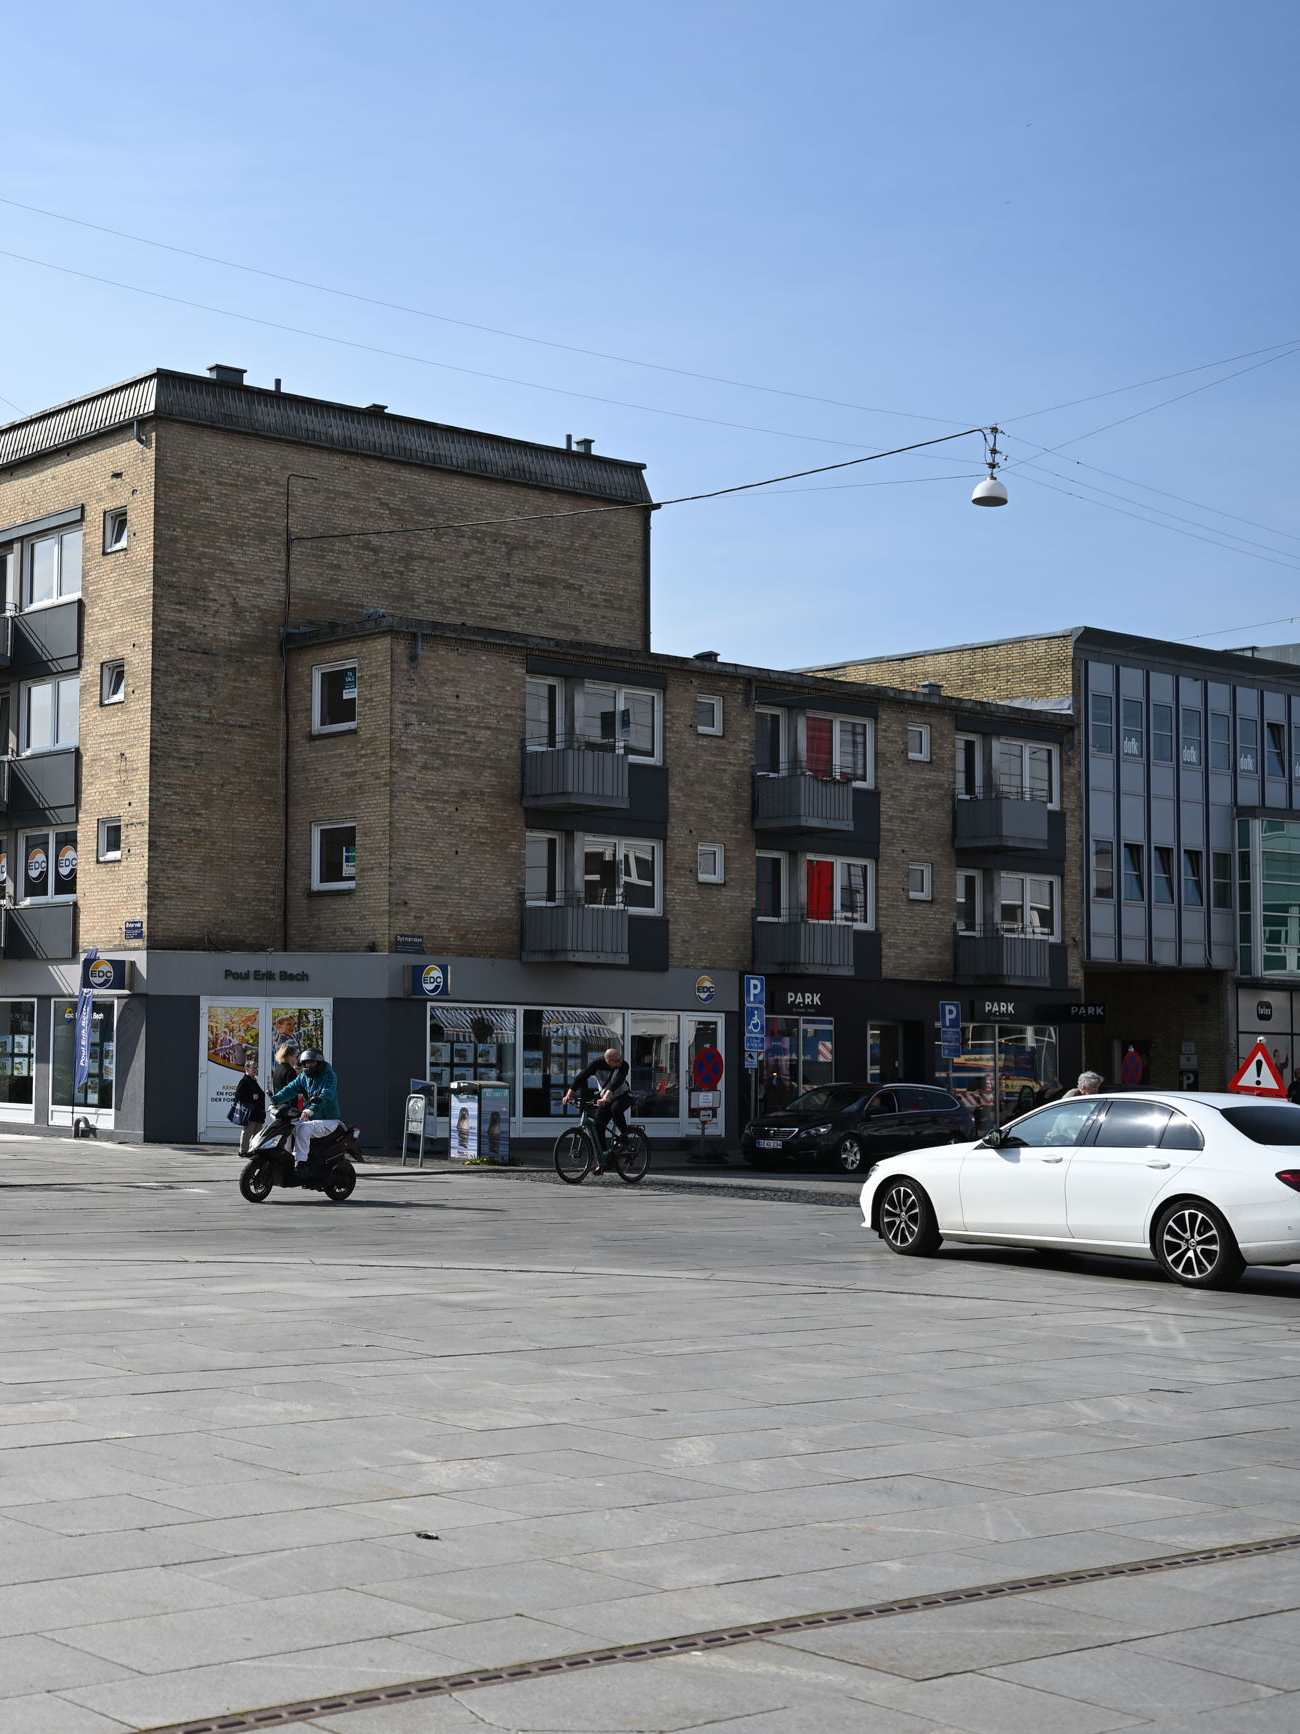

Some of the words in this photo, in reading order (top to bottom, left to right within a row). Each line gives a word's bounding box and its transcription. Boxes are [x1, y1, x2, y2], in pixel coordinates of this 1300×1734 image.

[28, 860, 46, 870] EDC
[59, 858, 77, 868] EDC
[90, 970, 113, 979] EDC
[224, 969, 250, 981] Poul
[253, 969, 277, 981] Erik
[279, 970, 309, 982] Bech
[423, 976, 442, 985] EDC
[696, 985, 715, 994] EDC
[750, 979, 761, 1002] P
[787, 992, 822, 1006] PARK
[985, 1001, 1015, 1014] PARK
[1070, 1006, 1104, 1016] PARK
[945, 1005, 957, 1026] P
